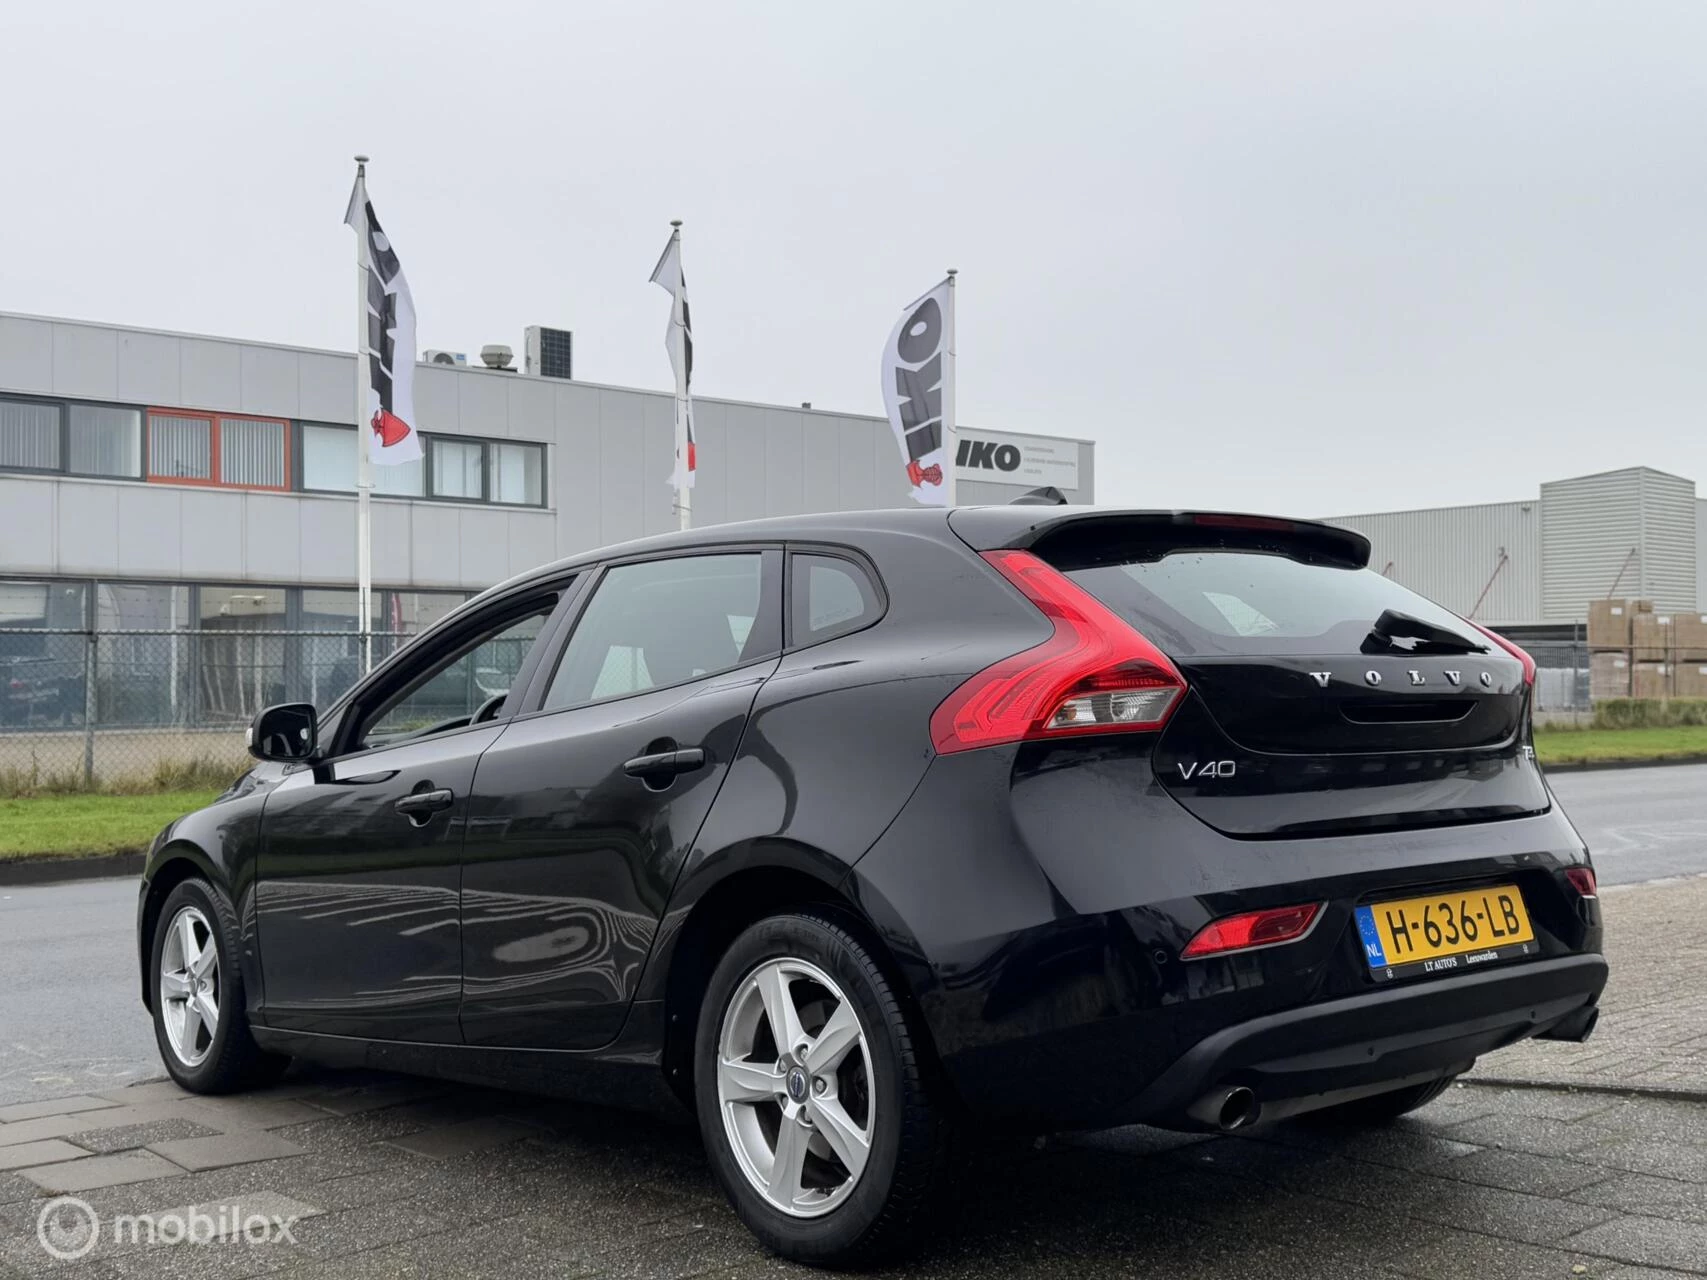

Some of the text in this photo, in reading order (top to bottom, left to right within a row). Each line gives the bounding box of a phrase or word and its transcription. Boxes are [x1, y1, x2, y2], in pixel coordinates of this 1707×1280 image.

[956, 439, 1021, 472] IKO
[1309, 670, 1492, 688] VOLVO
[1177, 760, 1236, 780] V40
[1385, 894, 1520, 954] H-636-LB
[1366, 943, 1382, 957] NL
[1424, 961, 1434, 972] LT
[1434, 956, 1458, 970] AUTO'S
